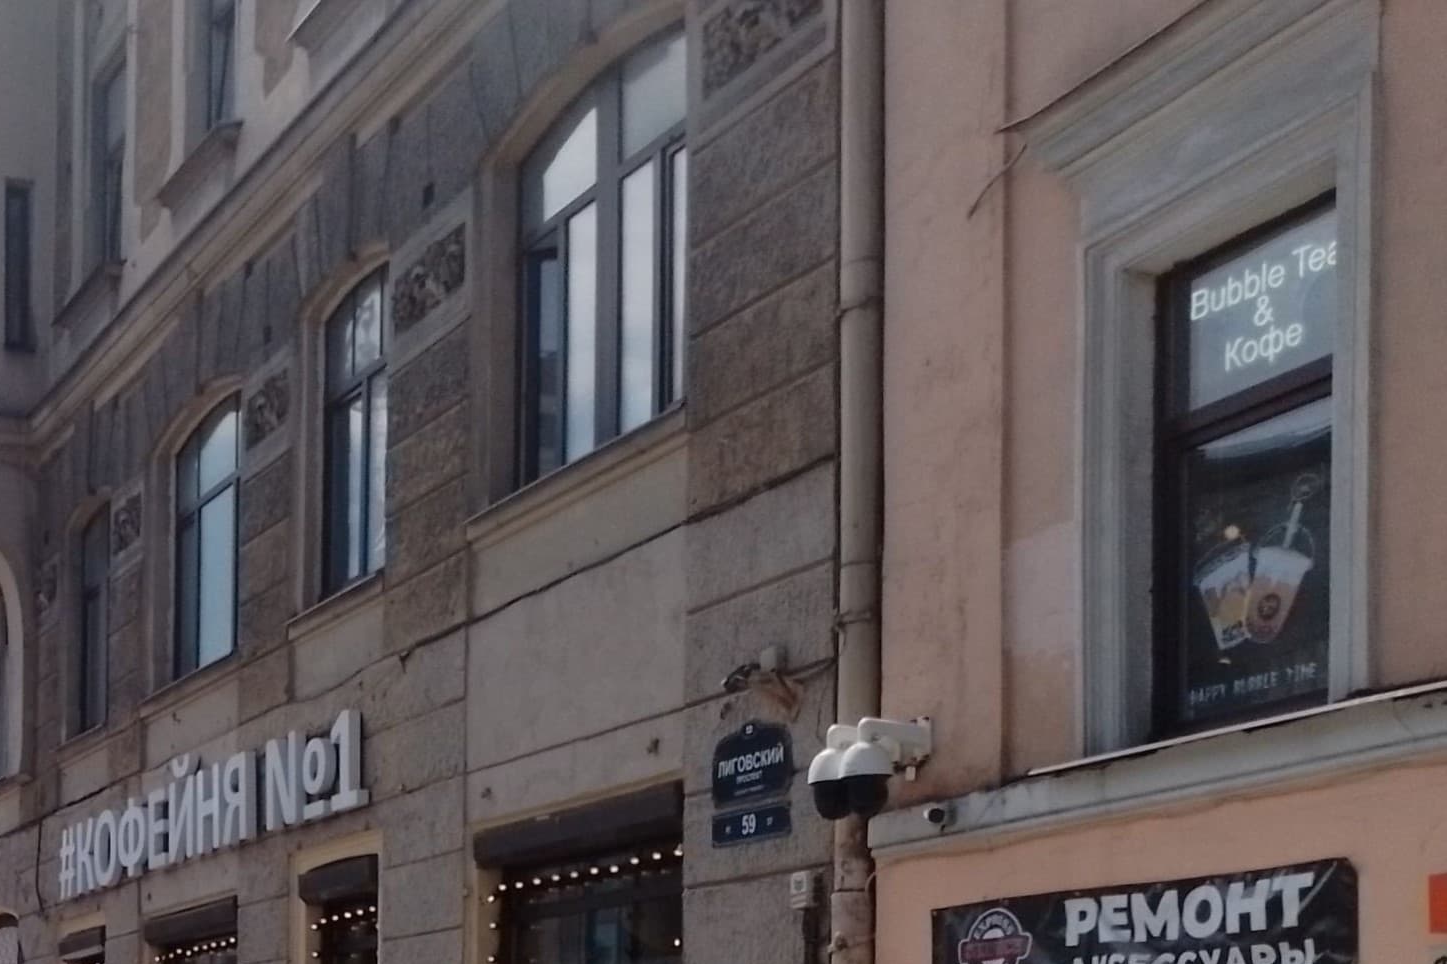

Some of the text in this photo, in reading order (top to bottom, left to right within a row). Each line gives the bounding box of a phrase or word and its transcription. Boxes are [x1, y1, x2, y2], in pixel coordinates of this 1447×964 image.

[1190, 261, 1285, 321] Bubble
[1253, 296, 1274, 327] &
[1224, 322, 1303, 373] Кофе
[717, 741, 784, 779] ЛИГОВСКИЙ
[59, 751, 254, 900] #КОФЕЙНЯ
[741, 813, 757, 835] 59
[1064, 872, 1314, 947] РЕМОНТ
